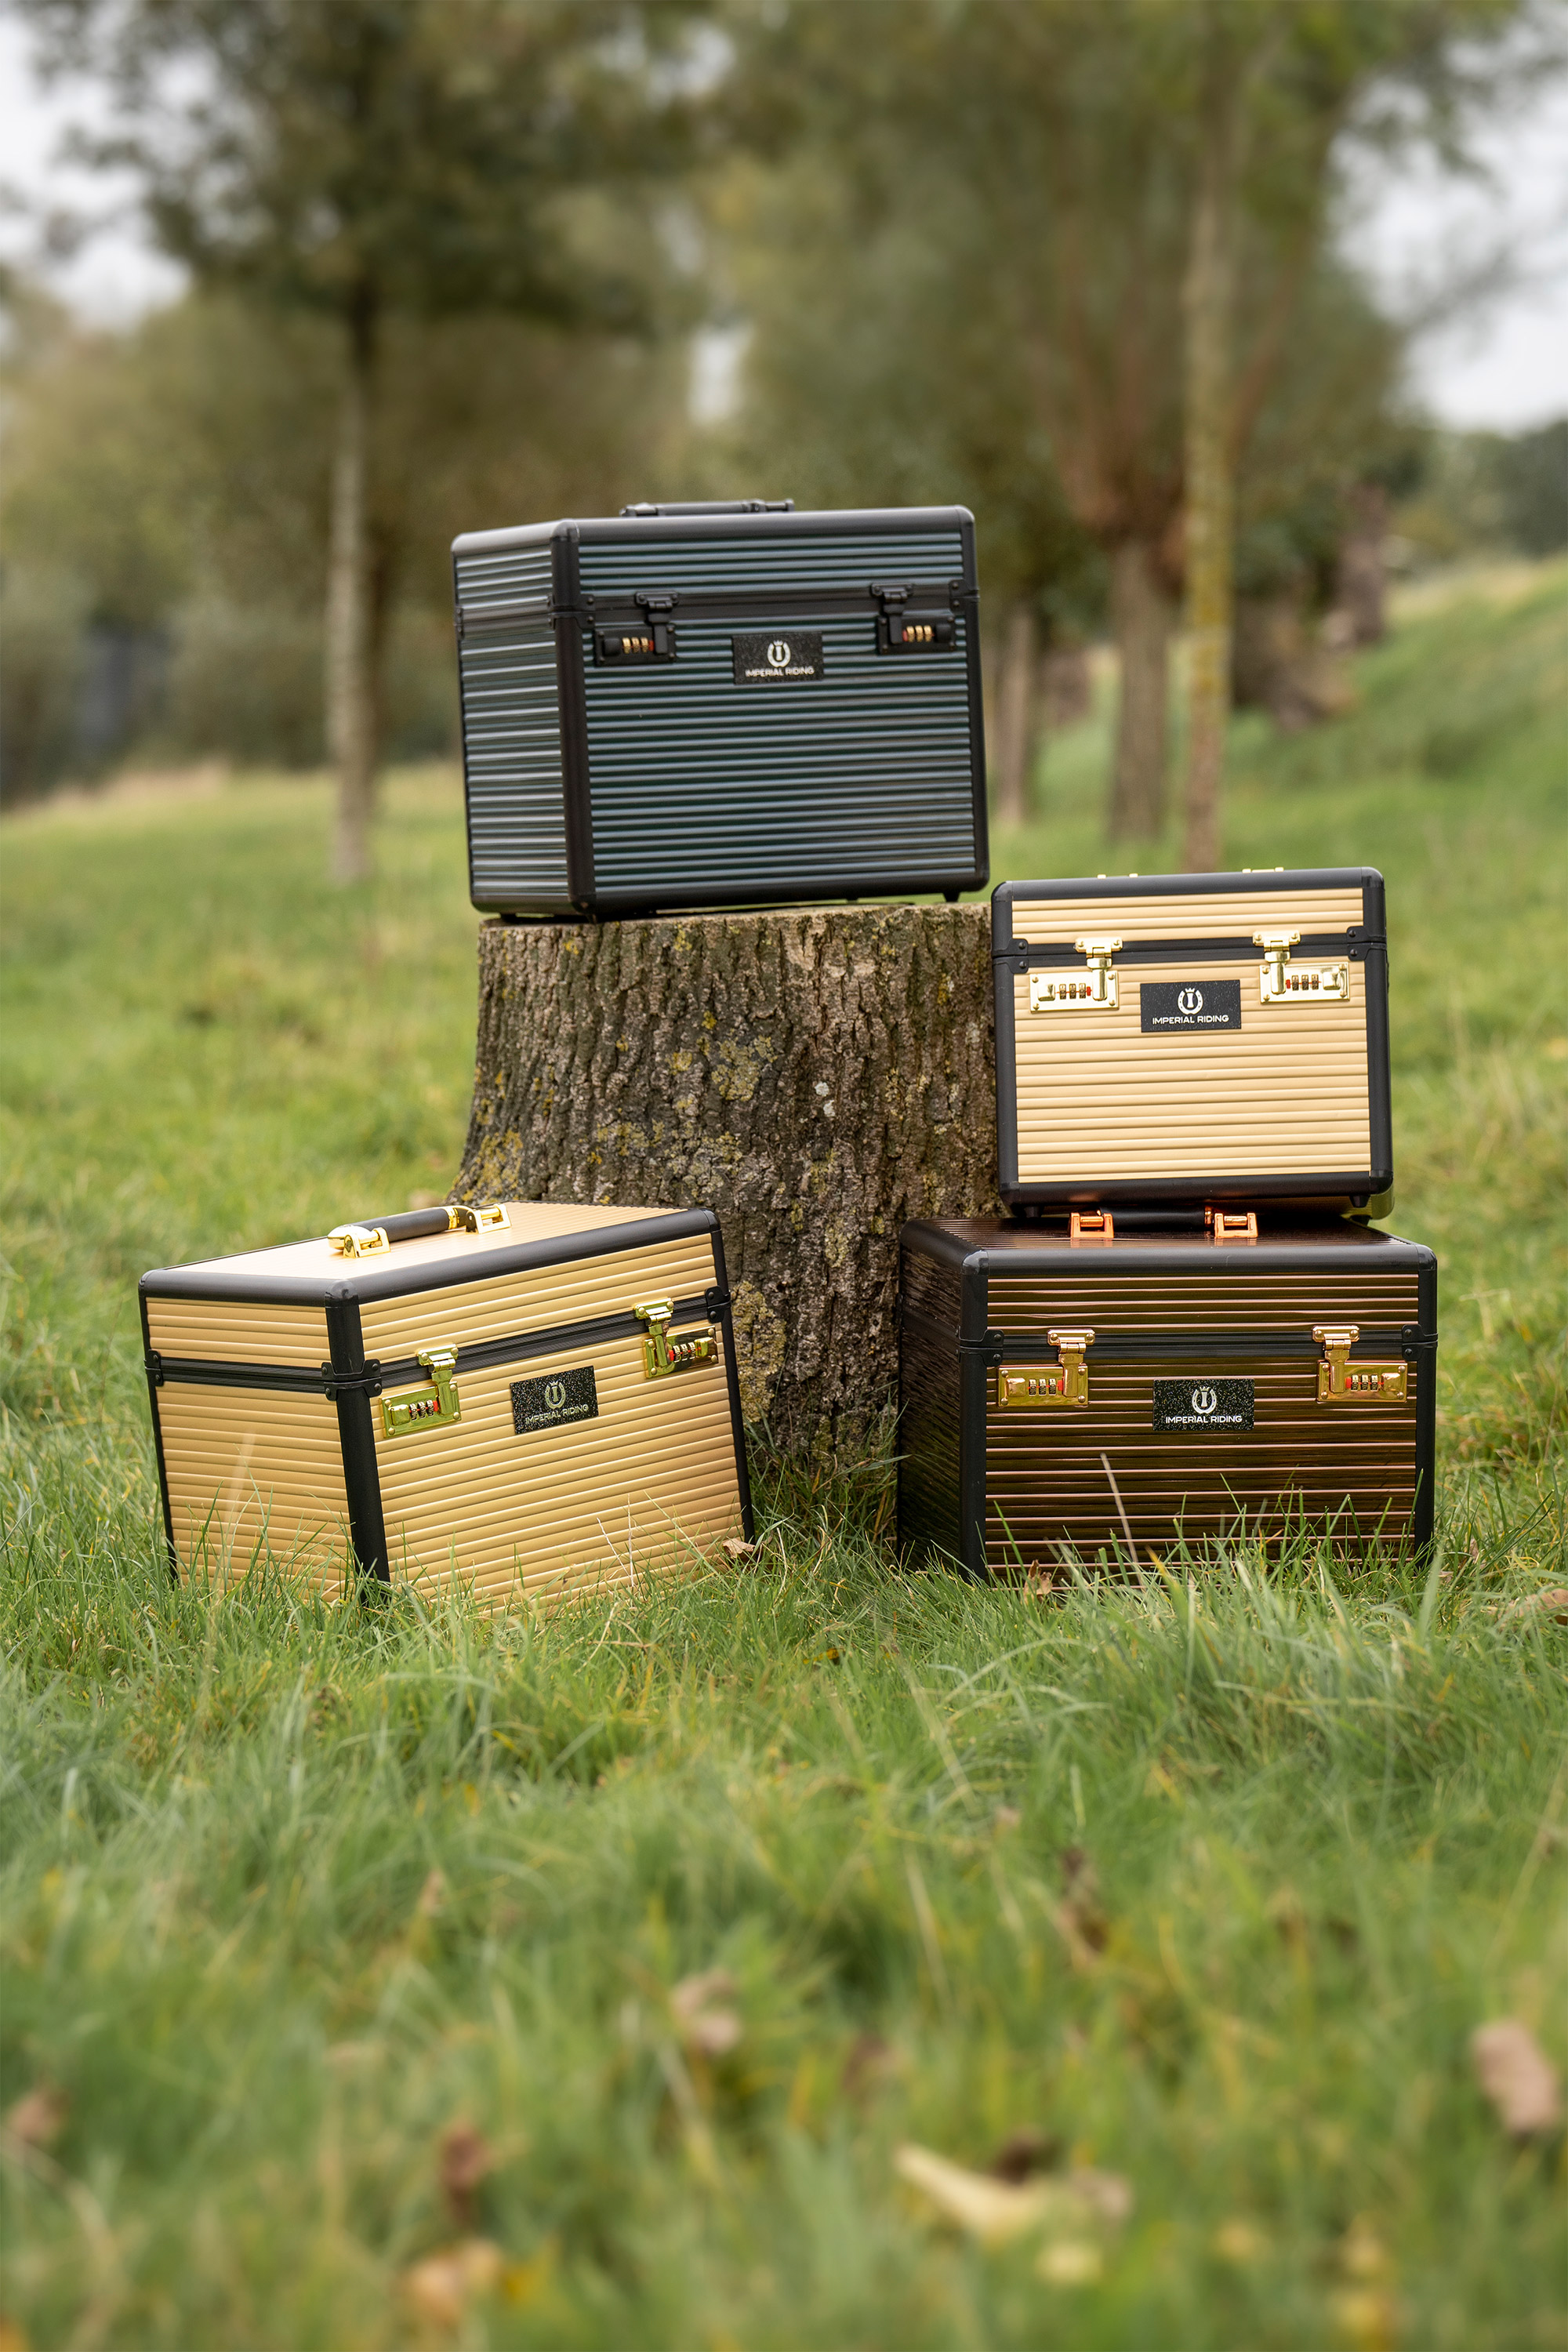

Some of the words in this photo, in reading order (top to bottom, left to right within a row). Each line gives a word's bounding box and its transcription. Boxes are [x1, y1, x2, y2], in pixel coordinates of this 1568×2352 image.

[1152, 1016, 1195, 1025] IMPERIAL
[1197, 1014, 1229, 1023] RIDING
[524, 1410, 561, 1425] IMPERIAL
[562, 1403, 589, 1417] RIDING
[1165, 1414, 1209, 1424] IMPERIAL
[1210, 1414, 1243, 1423] RIDING
